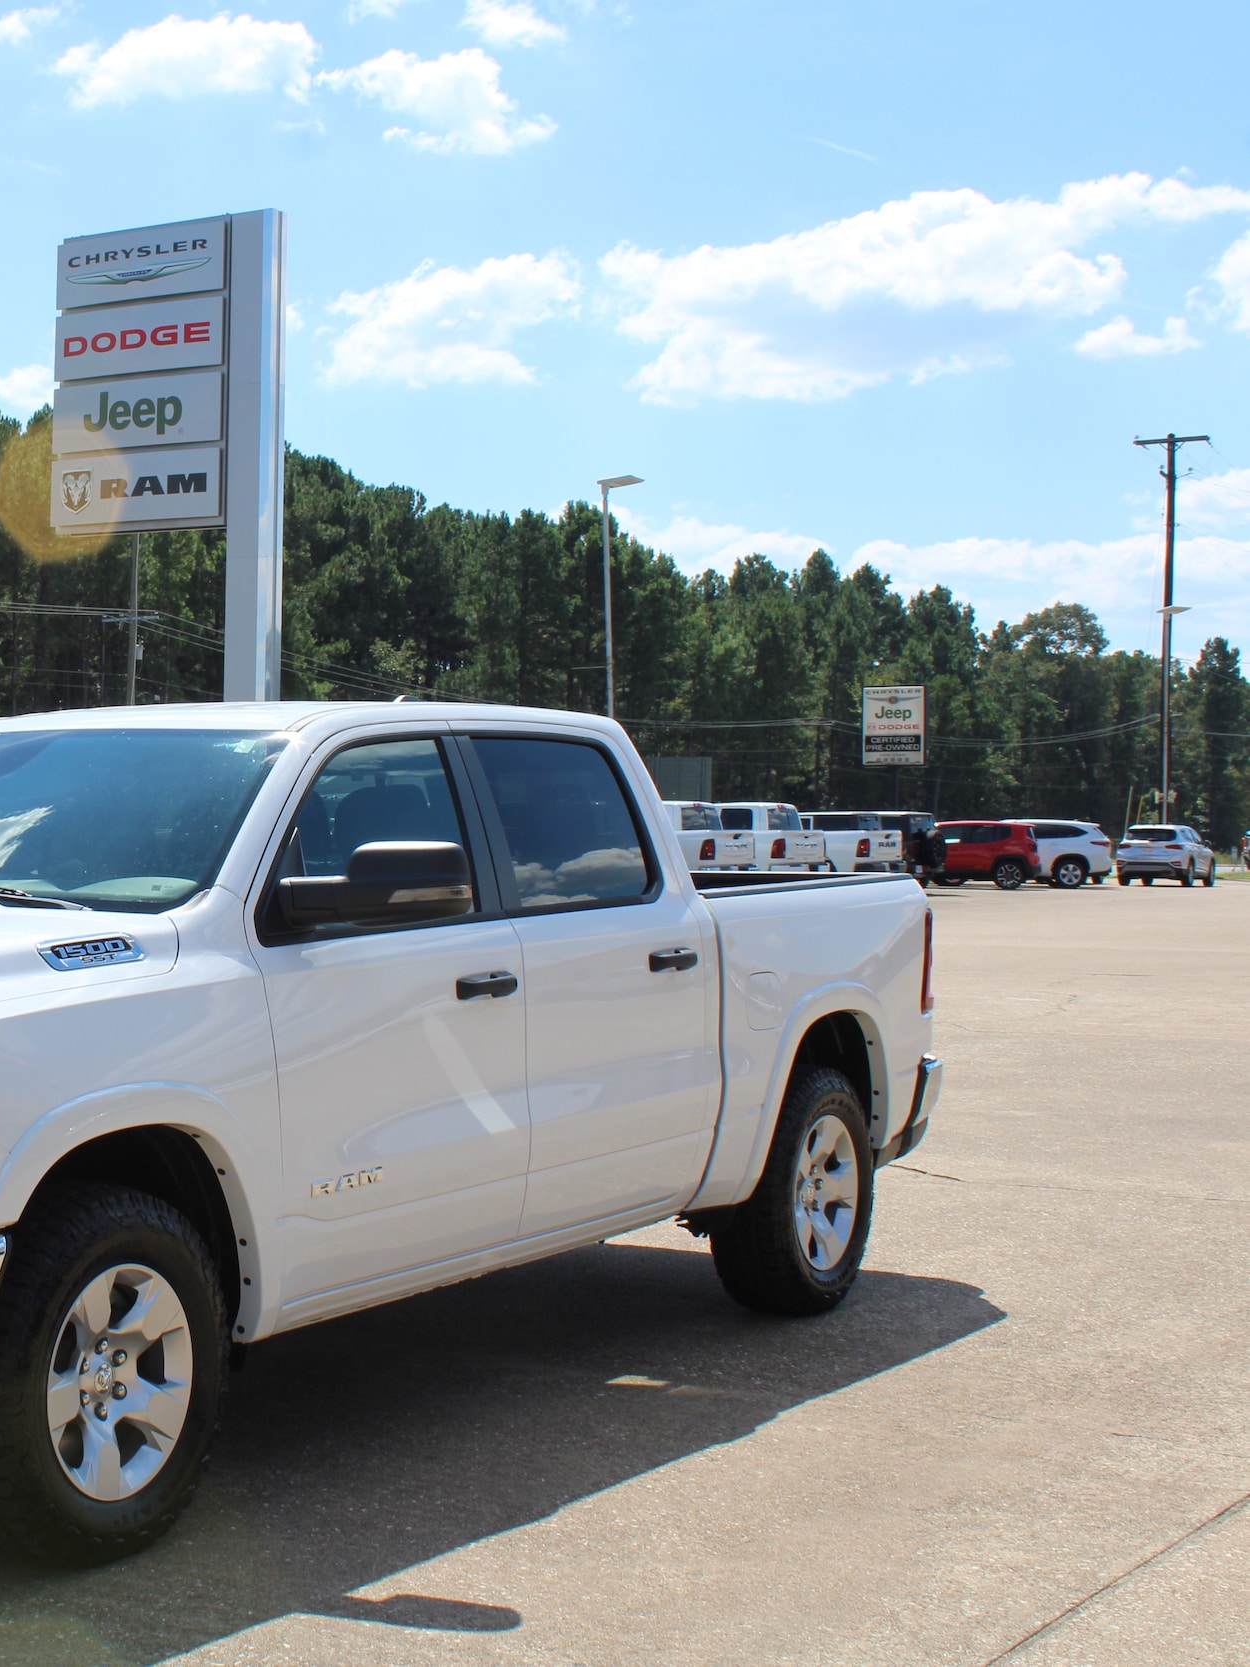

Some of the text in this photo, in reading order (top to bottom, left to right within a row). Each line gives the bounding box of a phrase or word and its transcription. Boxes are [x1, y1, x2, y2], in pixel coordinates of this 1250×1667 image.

[67, 238, 209, 268] CHRYSLER
[63, 321, 211, 358] DODGE
[83, 391, 183, 435] Jeep
[100, 472, 207, 500] RAM
[875, 706, 912, 721] Jeep
[55, 940, 125, 958] 1500
[310, 1166, 383, 1198] RAM
